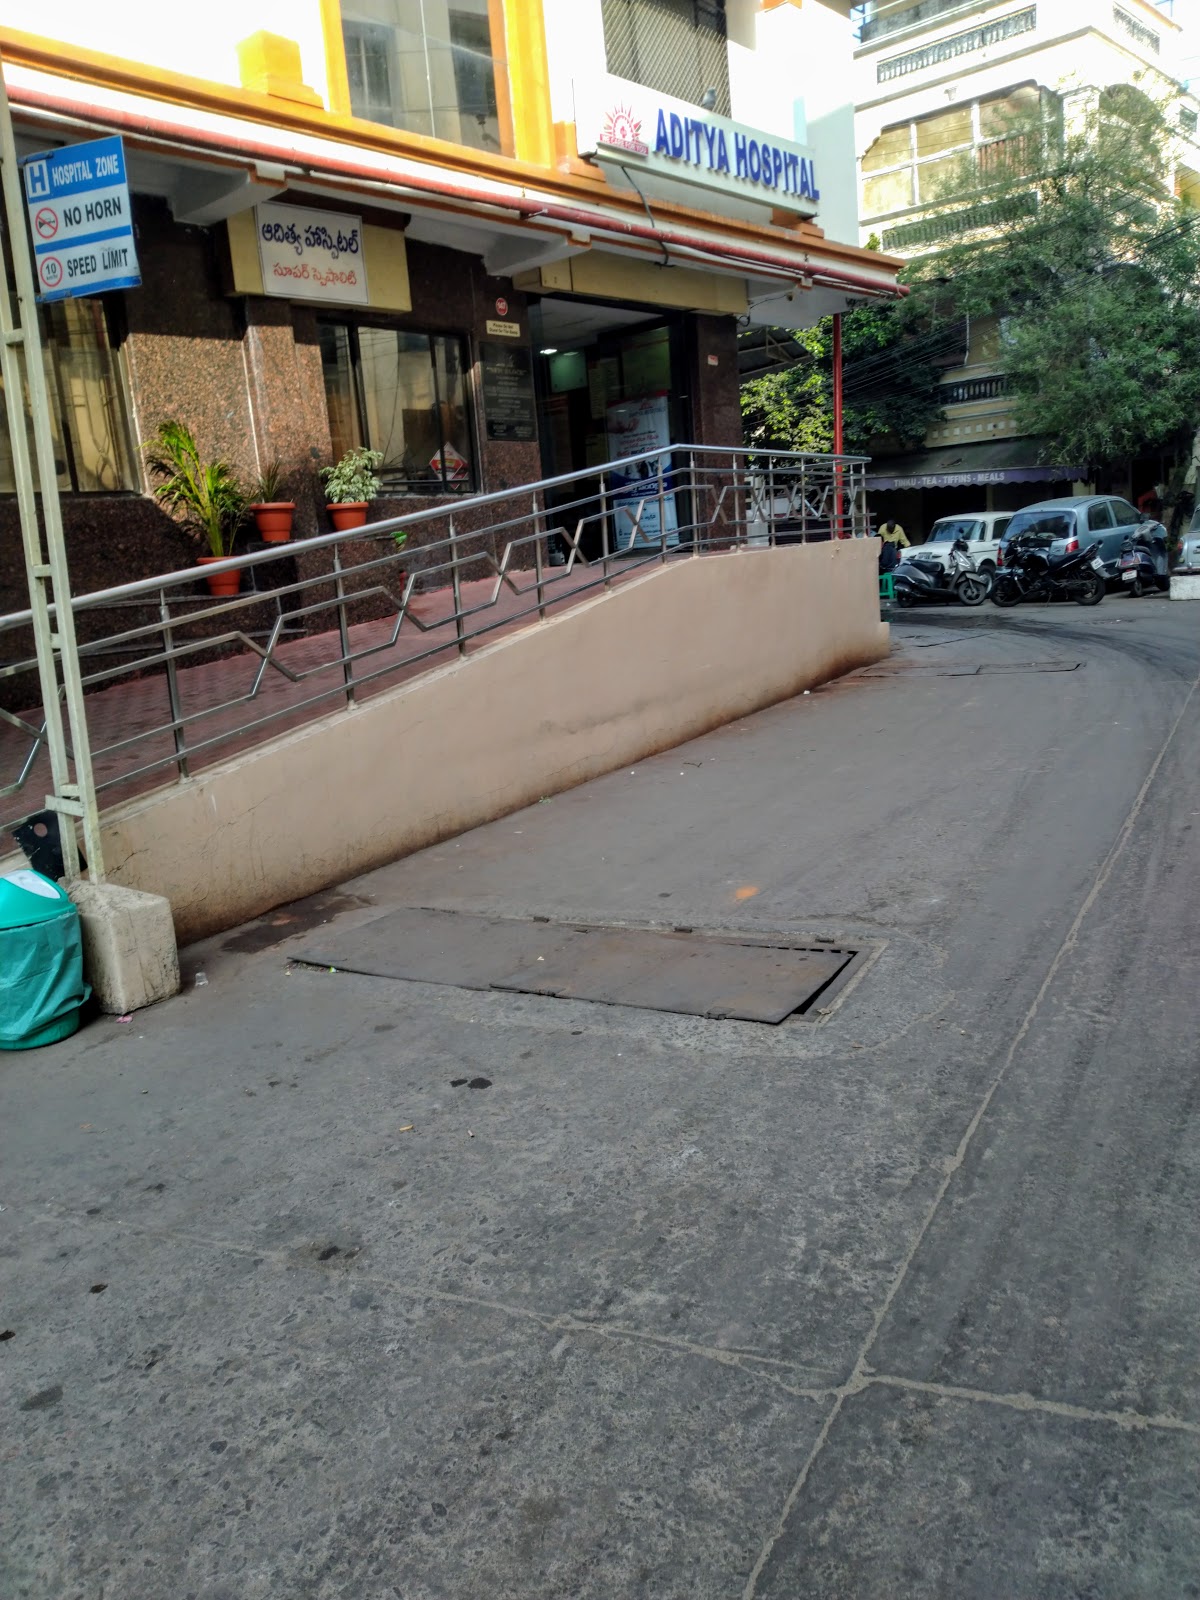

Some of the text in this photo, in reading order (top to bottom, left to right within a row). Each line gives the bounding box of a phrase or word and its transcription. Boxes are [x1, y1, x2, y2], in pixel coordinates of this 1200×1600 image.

[655, 108, 820, 200] ADITYA HOSPITAL
[30, 164, 47, 194] H
[52, 154, 119, 187] HOSPITAL ZONE
[63, 197, 122, 228] NO HORN
[262, 223, 303, 256] ఆదిత్య
[45, 262, 57, 275] 10
[67, 249, 128, 278] SPEED LIMIT
[273, 262, 310, 279] సూపర్
[922, 476, 937, 485] TEA
[943, 474, 972, 484] TIFFINS
[977, 472, 1005, 482] MEALS
